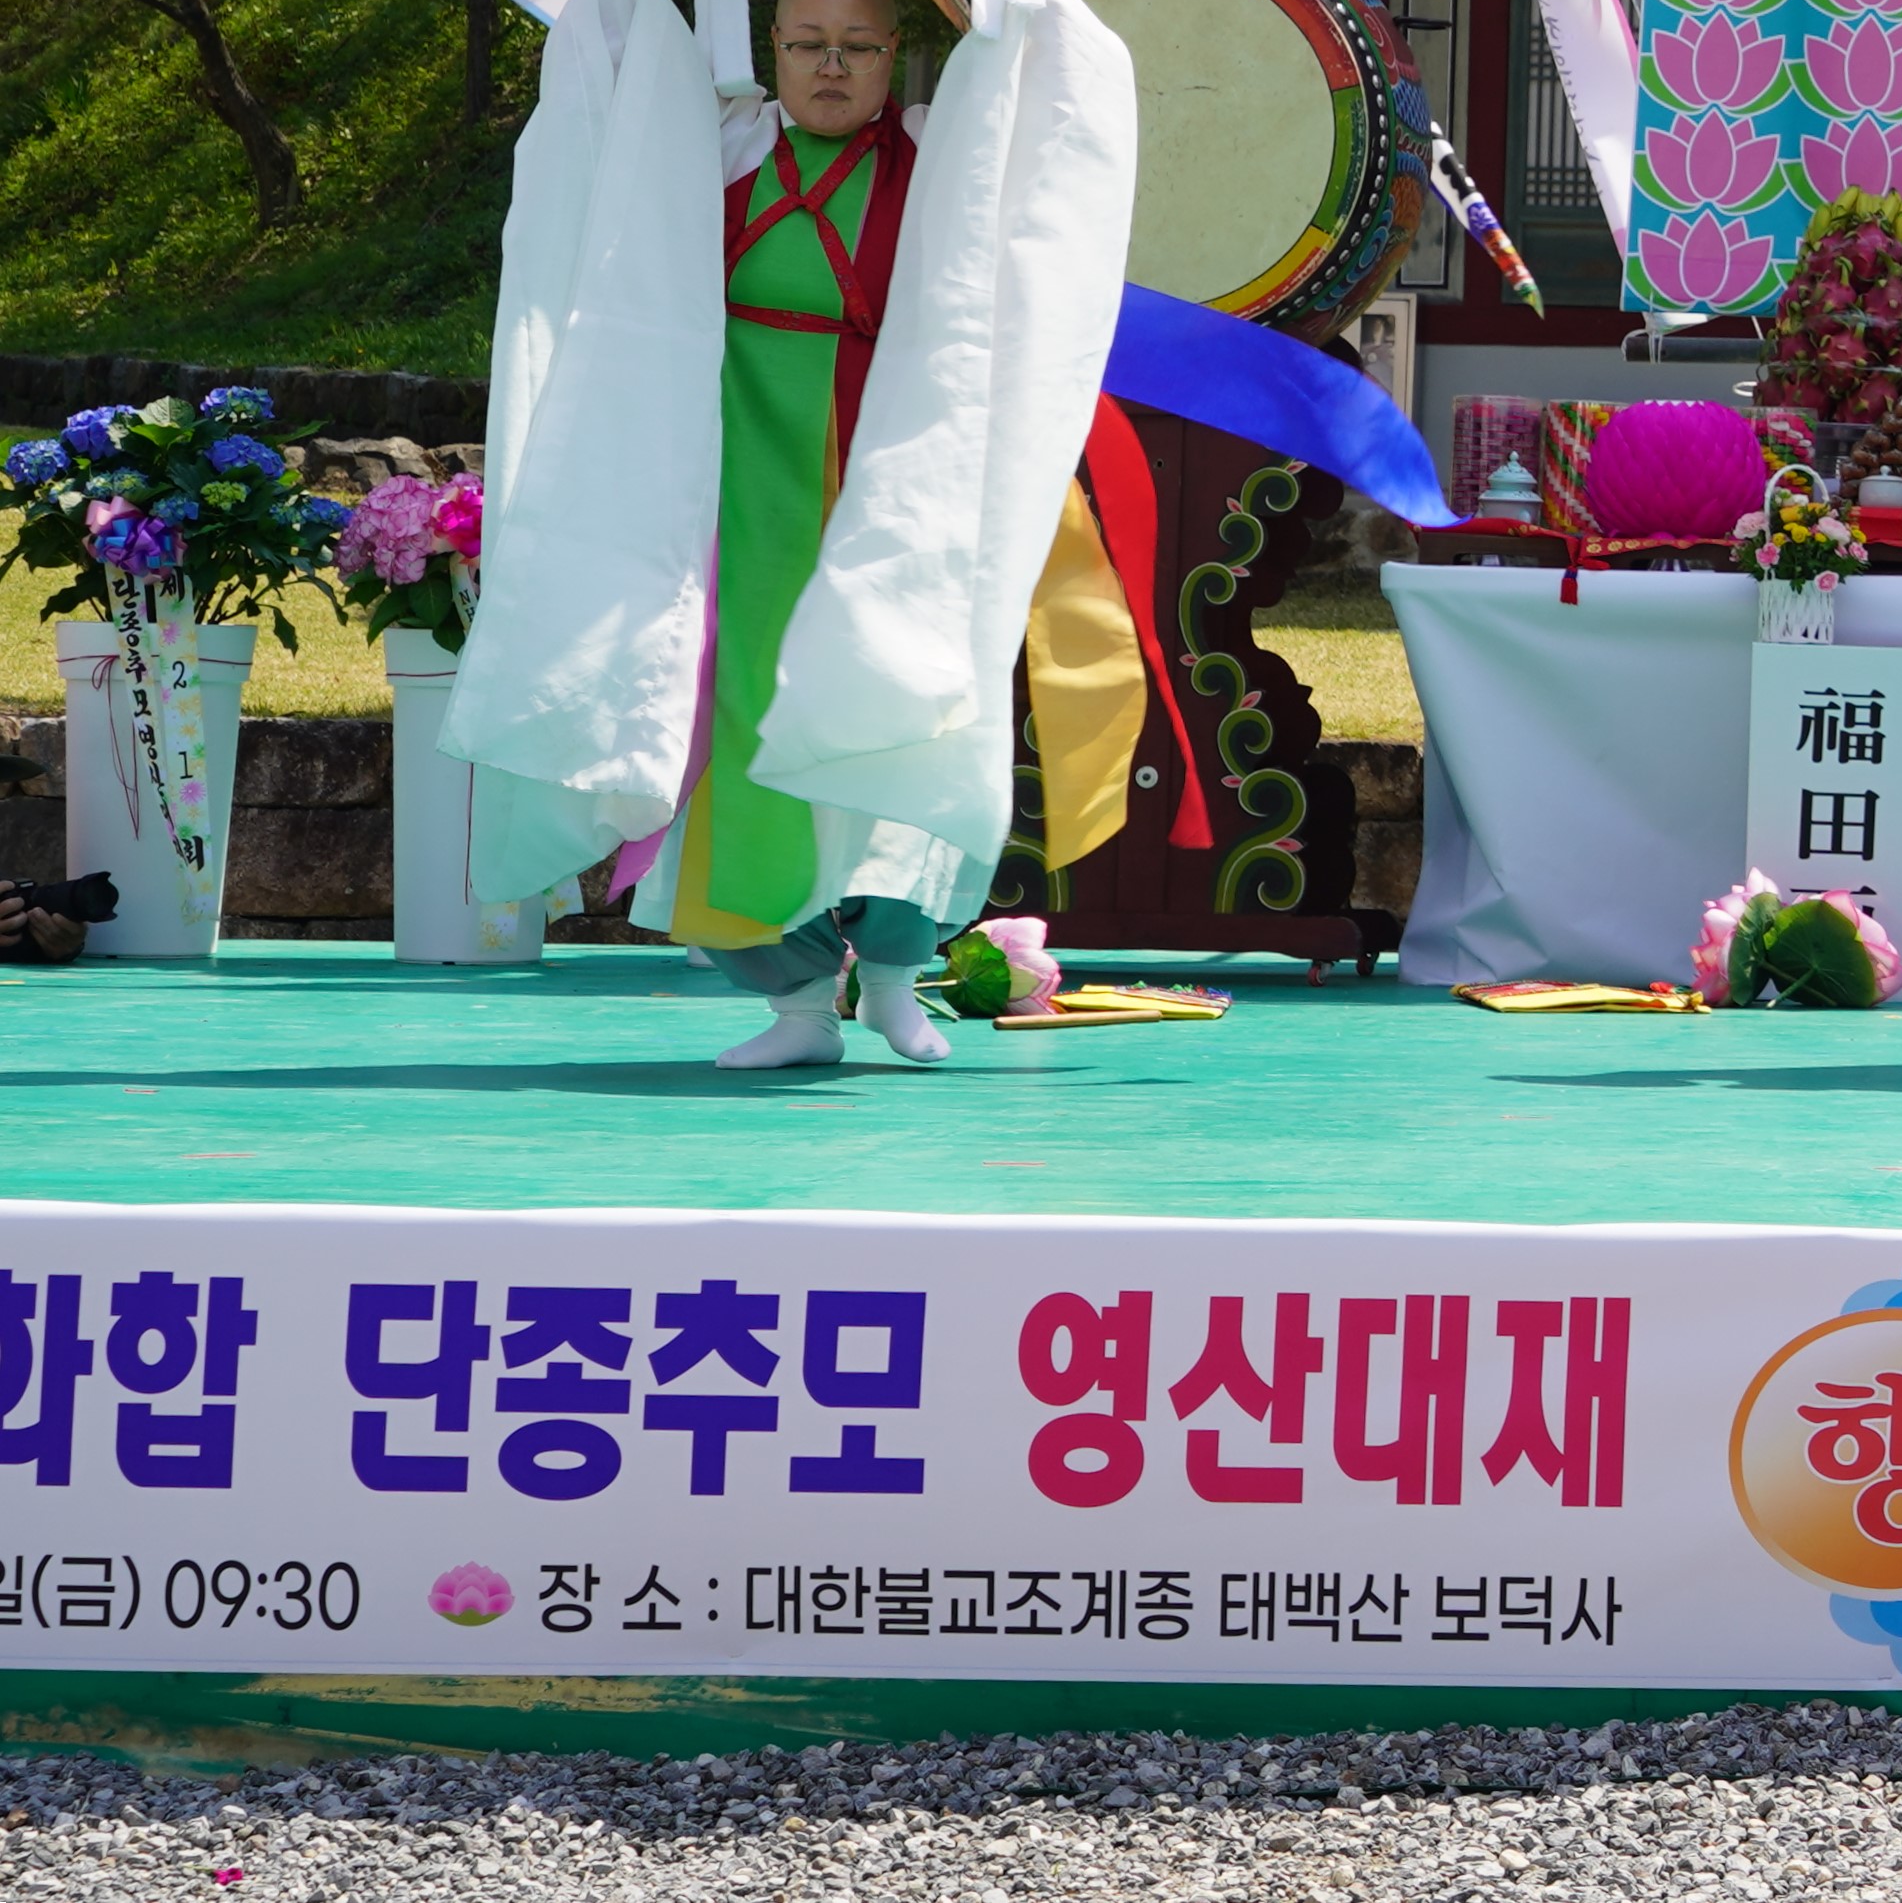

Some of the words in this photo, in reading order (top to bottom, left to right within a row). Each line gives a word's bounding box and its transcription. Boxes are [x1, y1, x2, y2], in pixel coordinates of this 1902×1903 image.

[345, 1279, 927, 1501] 단종추모
[1018, 1290, 1631, 1508] 영산대재
[165, 1559, 360, 1631] 09:30
[538, 1563, 600, 1633] 장
[622, 1564, 682, 1631] 소
[746, 1564, 1193, 1641] 대한불교조계종
[1219, 1572, 1409, 1643] 태백산
[1431, 1576, 1623, 1647] 보덕사
